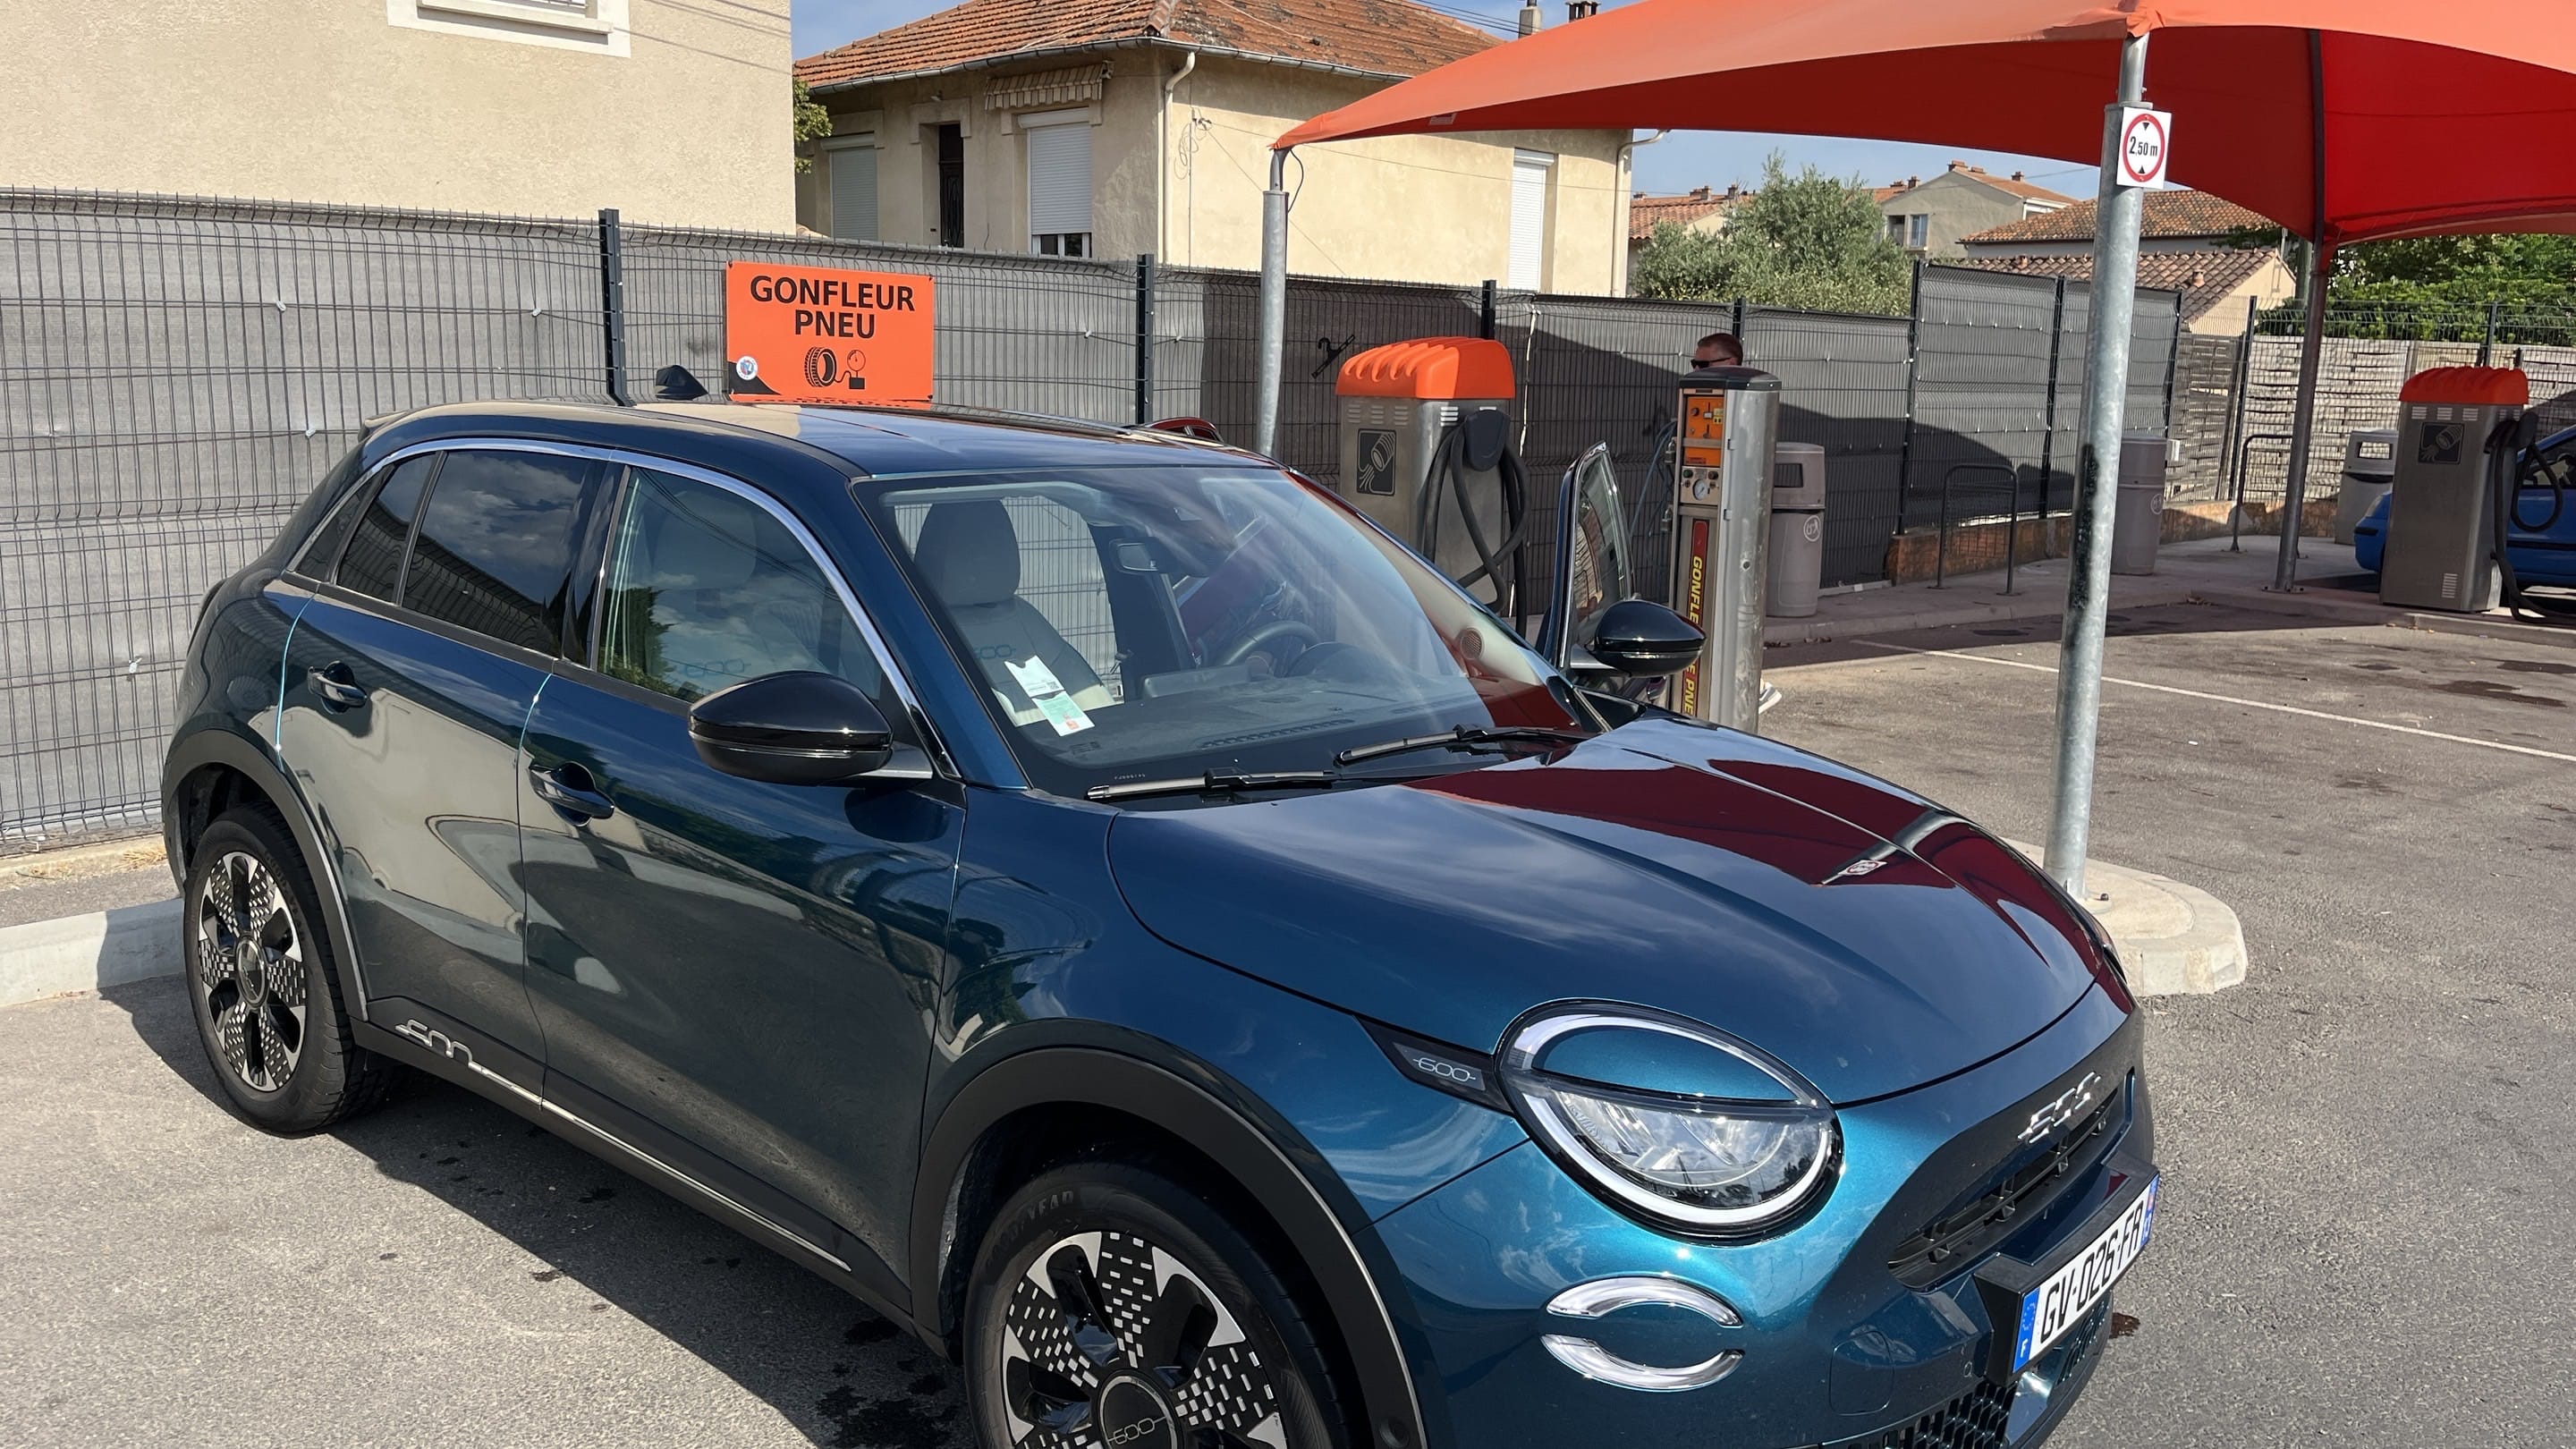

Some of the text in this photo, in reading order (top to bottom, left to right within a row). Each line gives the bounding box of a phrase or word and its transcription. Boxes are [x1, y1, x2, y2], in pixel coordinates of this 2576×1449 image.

[2149, 144, 2158, 157] m
[750, 275, 915, 311] GONFLEUR
[794, 309, 875, 339] PNEU
[1689, 555, 1703, 624] GONFLE
[1684, 678, 1695, 716] PNE
[2039, 1200, 2144, 1344] GV-026-FA
[2019, 1336, 2029, 1360] F
[1113, 1418, 1156, 1445] 600
